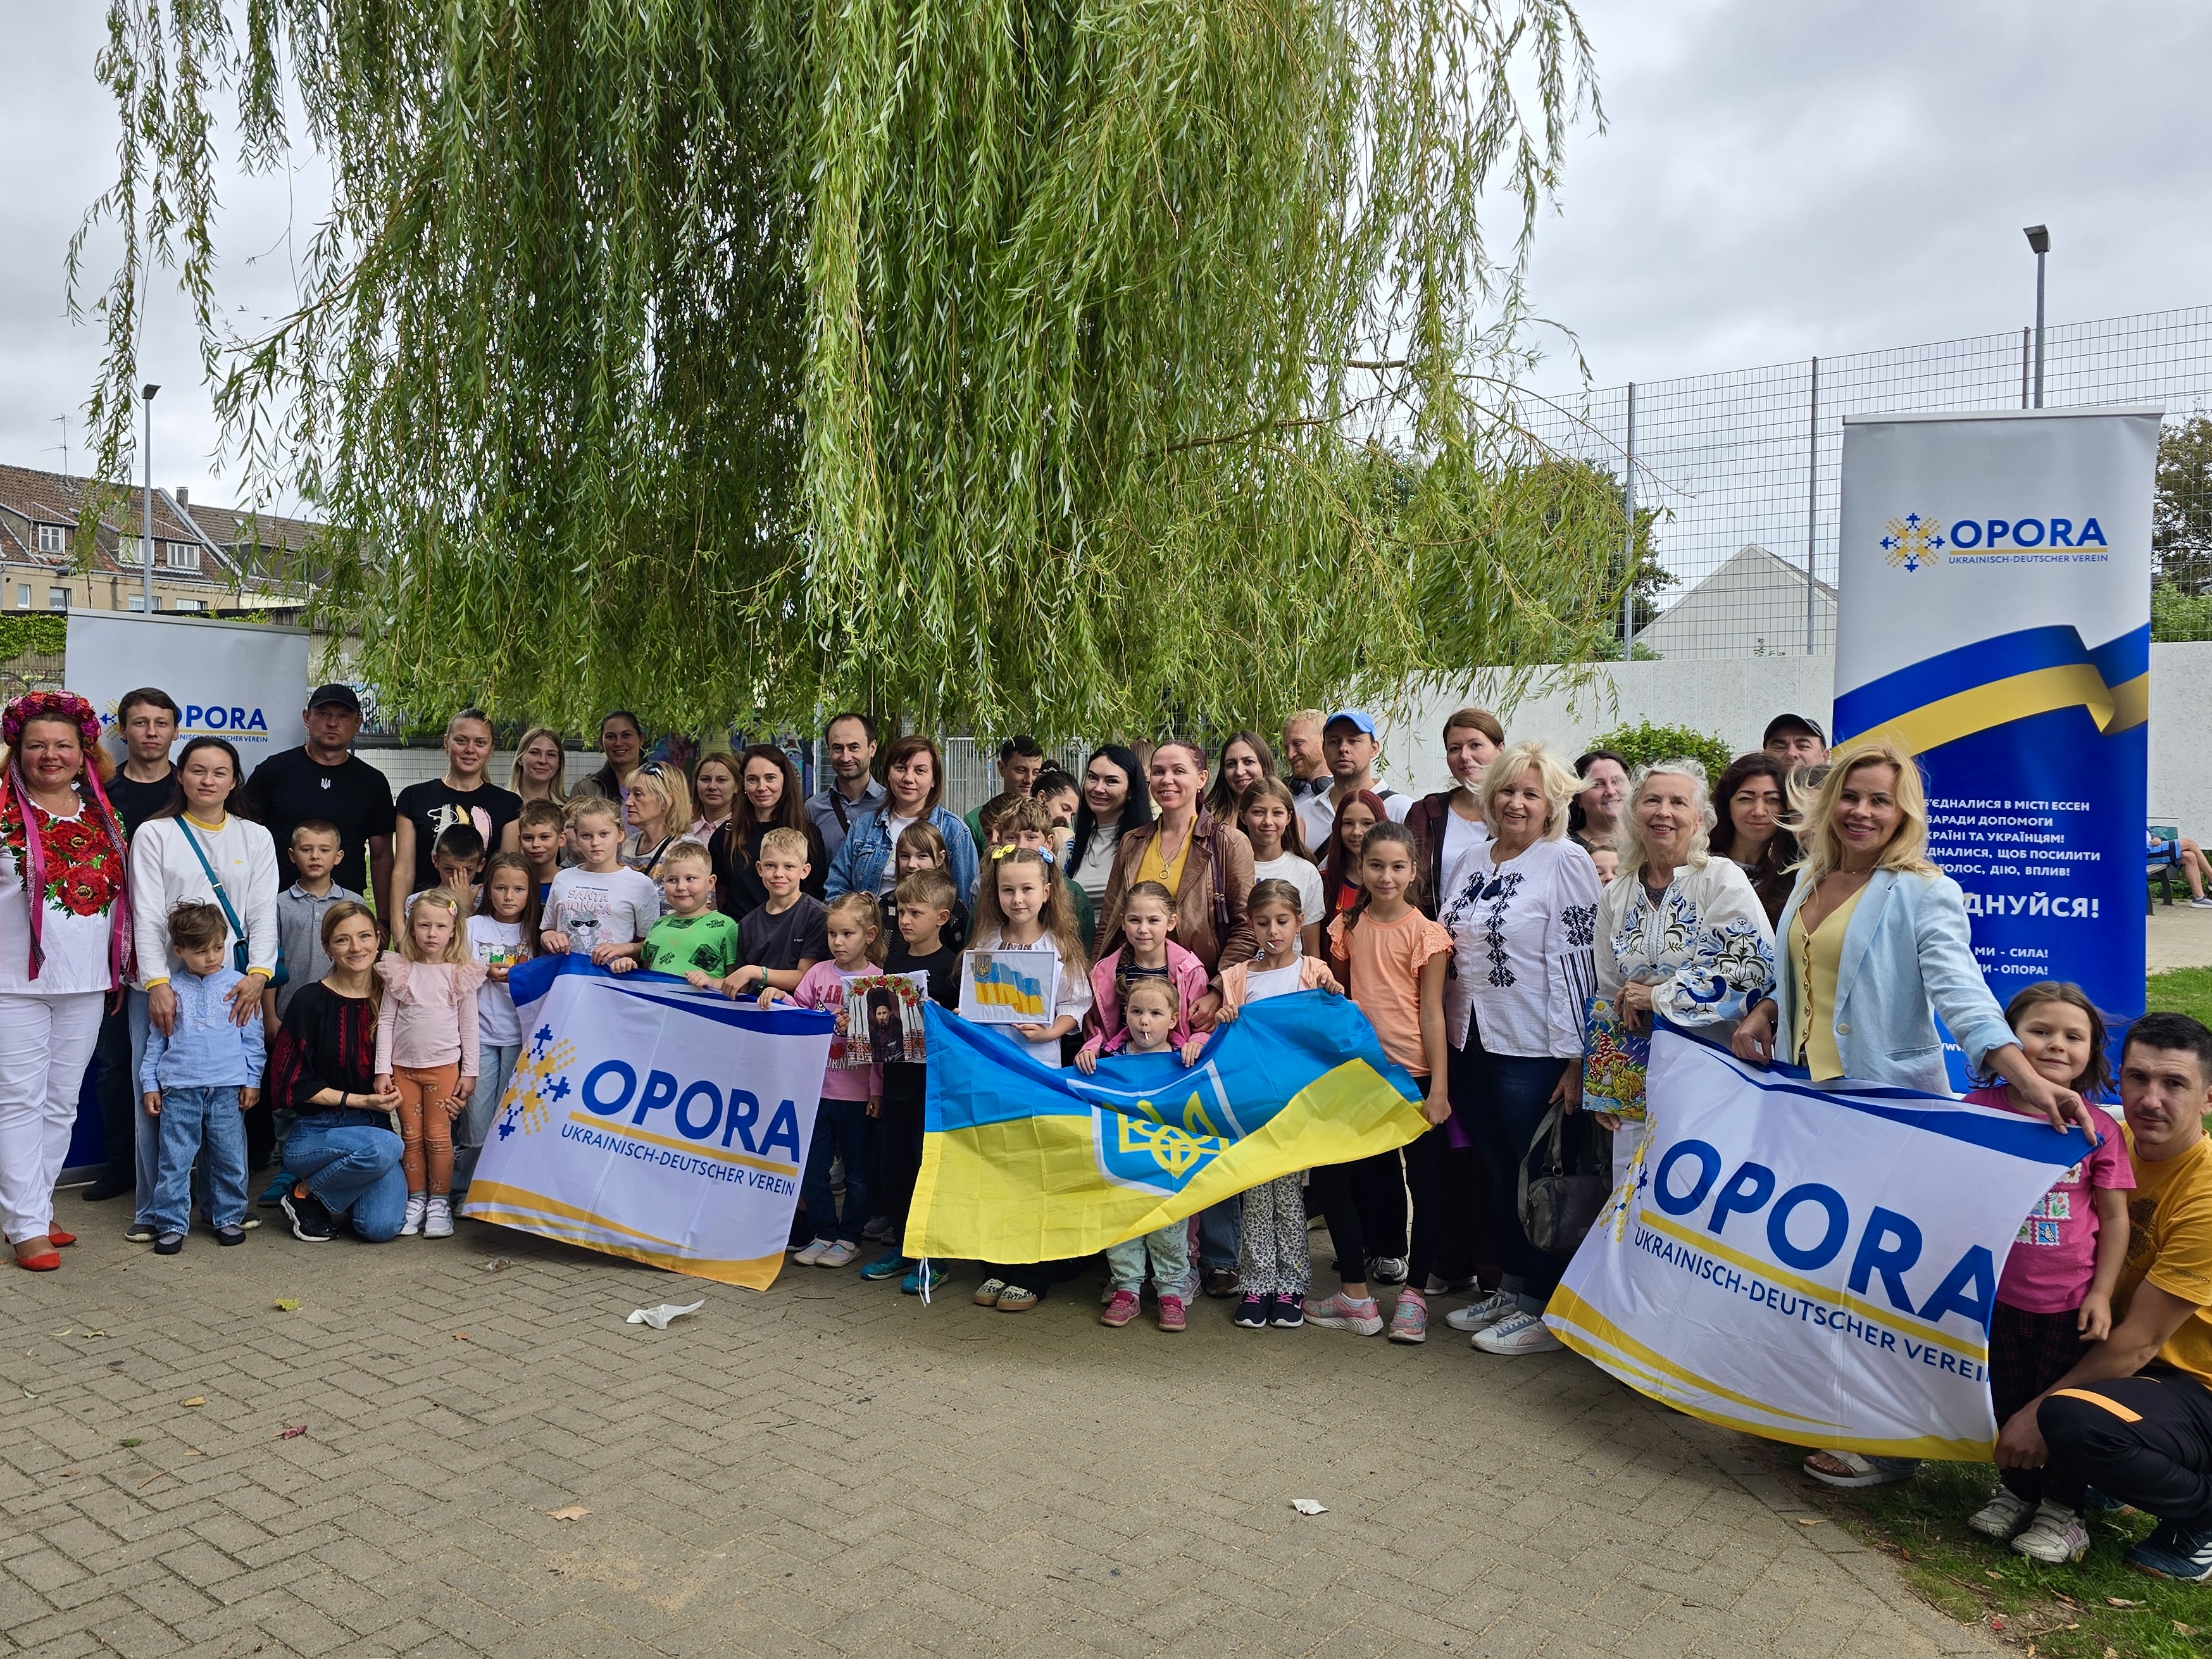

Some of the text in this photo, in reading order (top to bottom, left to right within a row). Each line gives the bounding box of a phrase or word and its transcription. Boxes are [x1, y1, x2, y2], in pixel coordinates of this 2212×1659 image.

[1950, 518, 2108, 549] OPORA
[1949, 555, 2070, 564] UKRAINISCH-DEUTSCHER
[177, 704, 268, 730] PORA
[1923, 798, 2090, 811] Б'ЄДНАЛИСЯ В МІСТІ ЕССЕН
[1926, 815, 2053, 827] ЗАРАДИ ДОПОМОГИ
[1925, 830, 2065, 844] КРАЇНІ ТА УКРАЇНЦЯМ!
[1997, 849, 2027, 860] ЩОБ
[2030, 850, 2100, 861] ПОСИЛИТИ
[1989, 865, 2020, 876] ДІЮ,
[2025, 866, 2070, 877] ВПЛИВ!
[567, 889, 609, 903] SANTA
[561, 899, 612, 916] MONICA
[1964, 891, 2099, 918] ДНУЙСЯ!
[1975, 947, 1996, 956] МИ
[2009, 948, 2049, 958] СИЛА!
[2001, 965, 2049, 975] ОПОРА!
[581, 1060, 801, 1163] OPORA
[561, 1124, 796, 1197] UKRAINISCH-DEUTSCHER VEREIN
[1653, 1139, 1997, 1341] OPORA
[2170, 1267, 2211, 1283] CROSSHATCH
[1634, 1225, 1989, 1383] UKRAINISCH-DEUTSCHER VEREI
